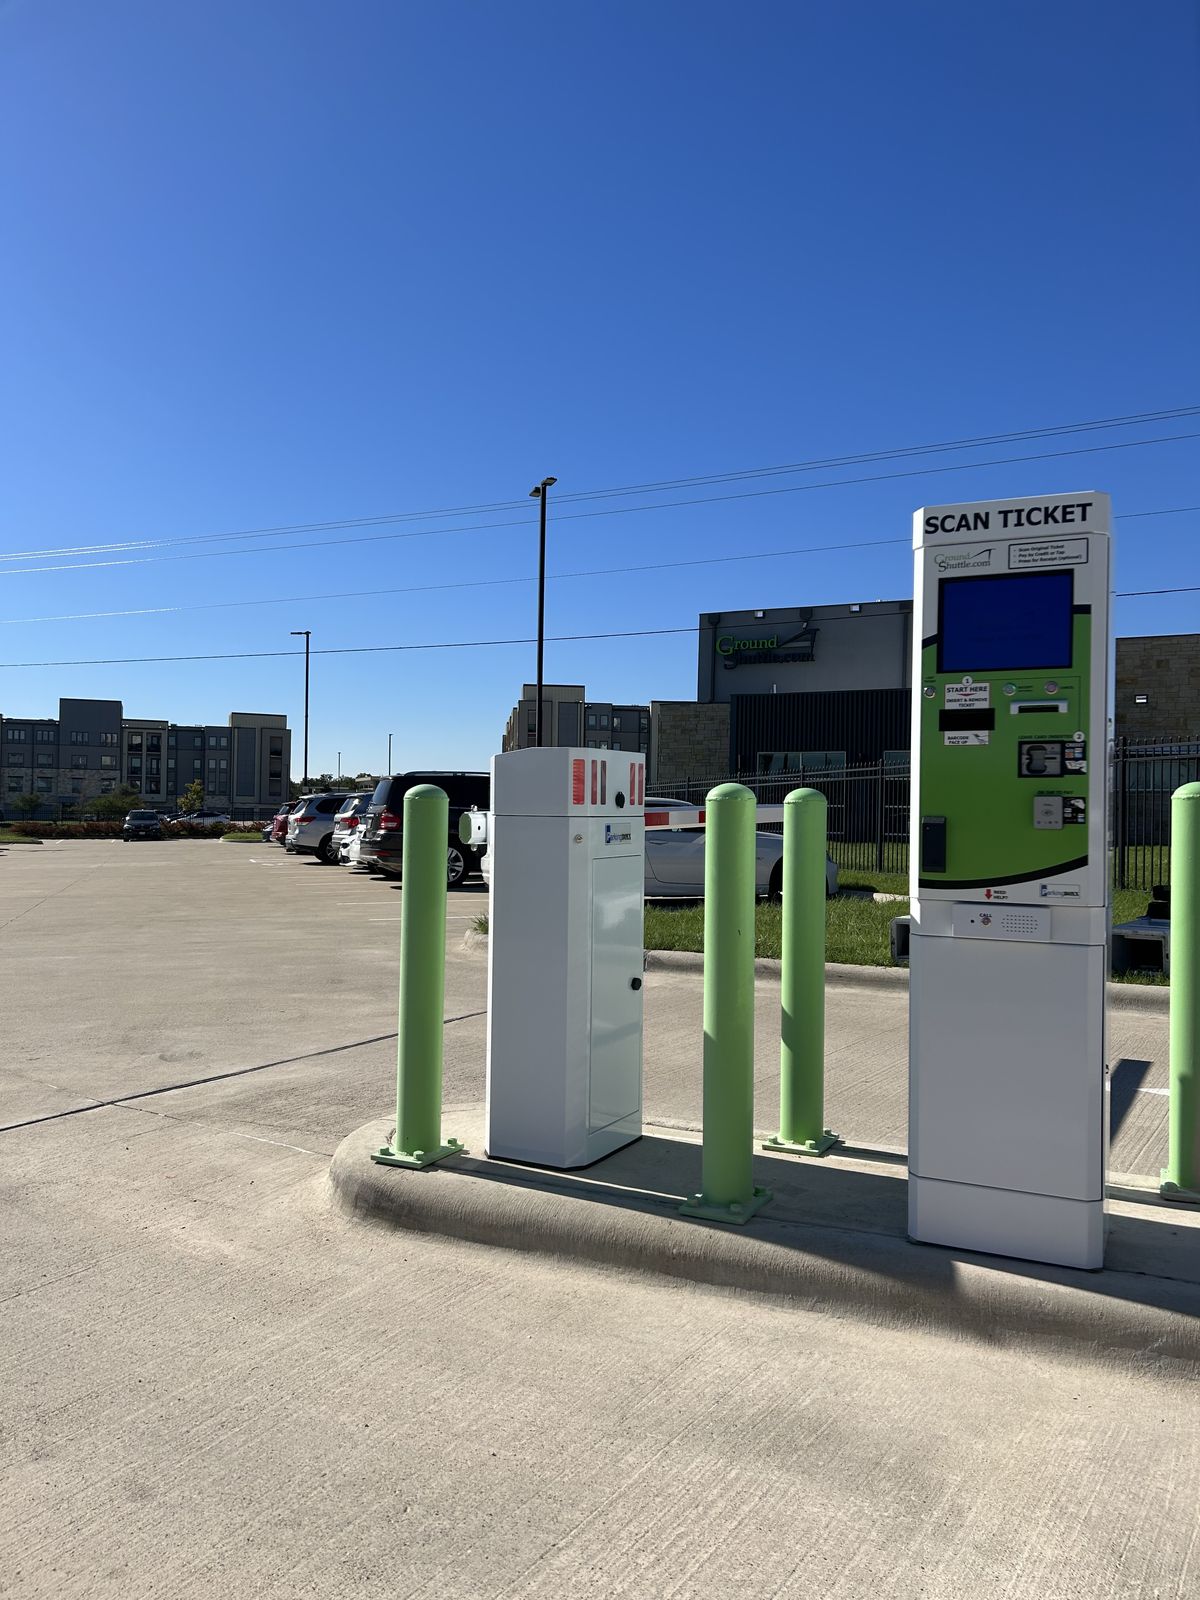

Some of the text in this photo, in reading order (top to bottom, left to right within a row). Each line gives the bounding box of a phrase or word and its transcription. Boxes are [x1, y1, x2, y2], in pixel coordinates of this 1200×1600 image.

[925, 502, 1093, 534] SCAN TICKET
[934, 552, 970, 564] Ground
[938, 560, 991, 572] Shuttle.com
[716, 634, 778, 655] Ground
